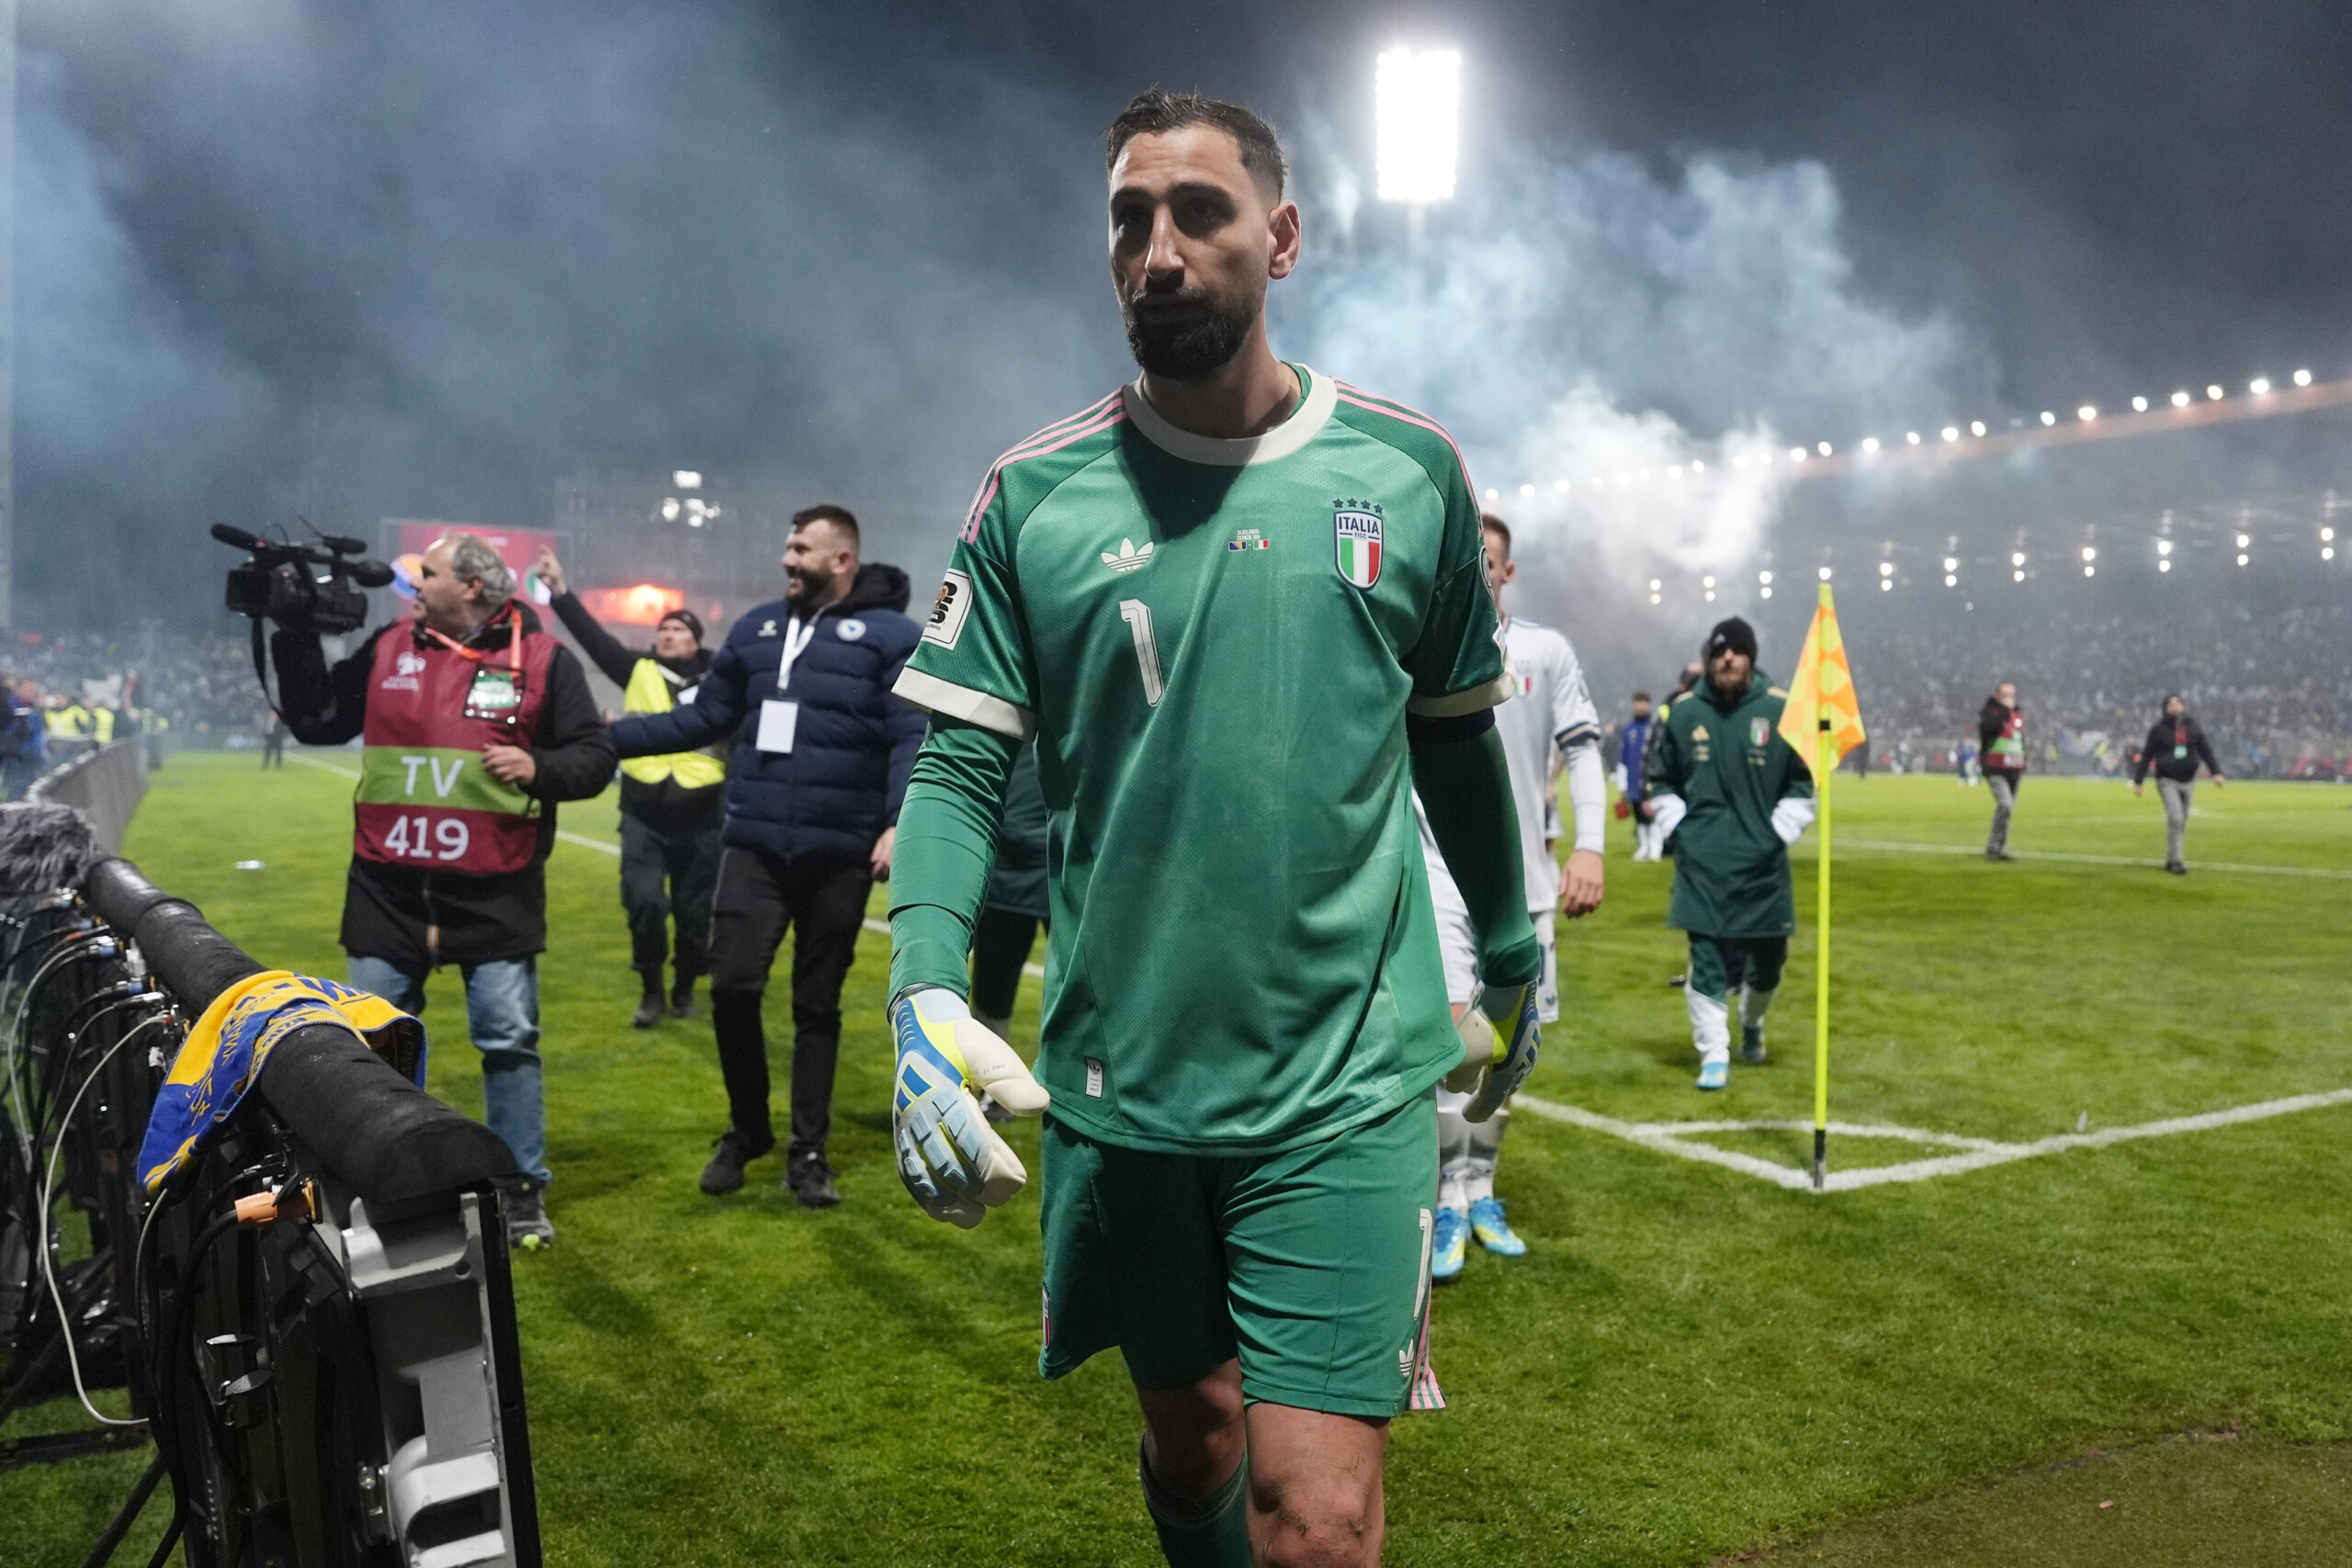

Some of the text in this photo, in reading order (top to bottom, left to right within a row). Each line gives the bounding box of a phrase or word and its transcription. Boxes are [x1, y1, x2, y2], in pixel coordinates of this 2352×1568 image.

[1339, 516, 1380, 536] ITALIA
[1119, 598, 1164, 707] 1
[401, 756, 464, 797] TV
[384, 815, 469, 861] 419
